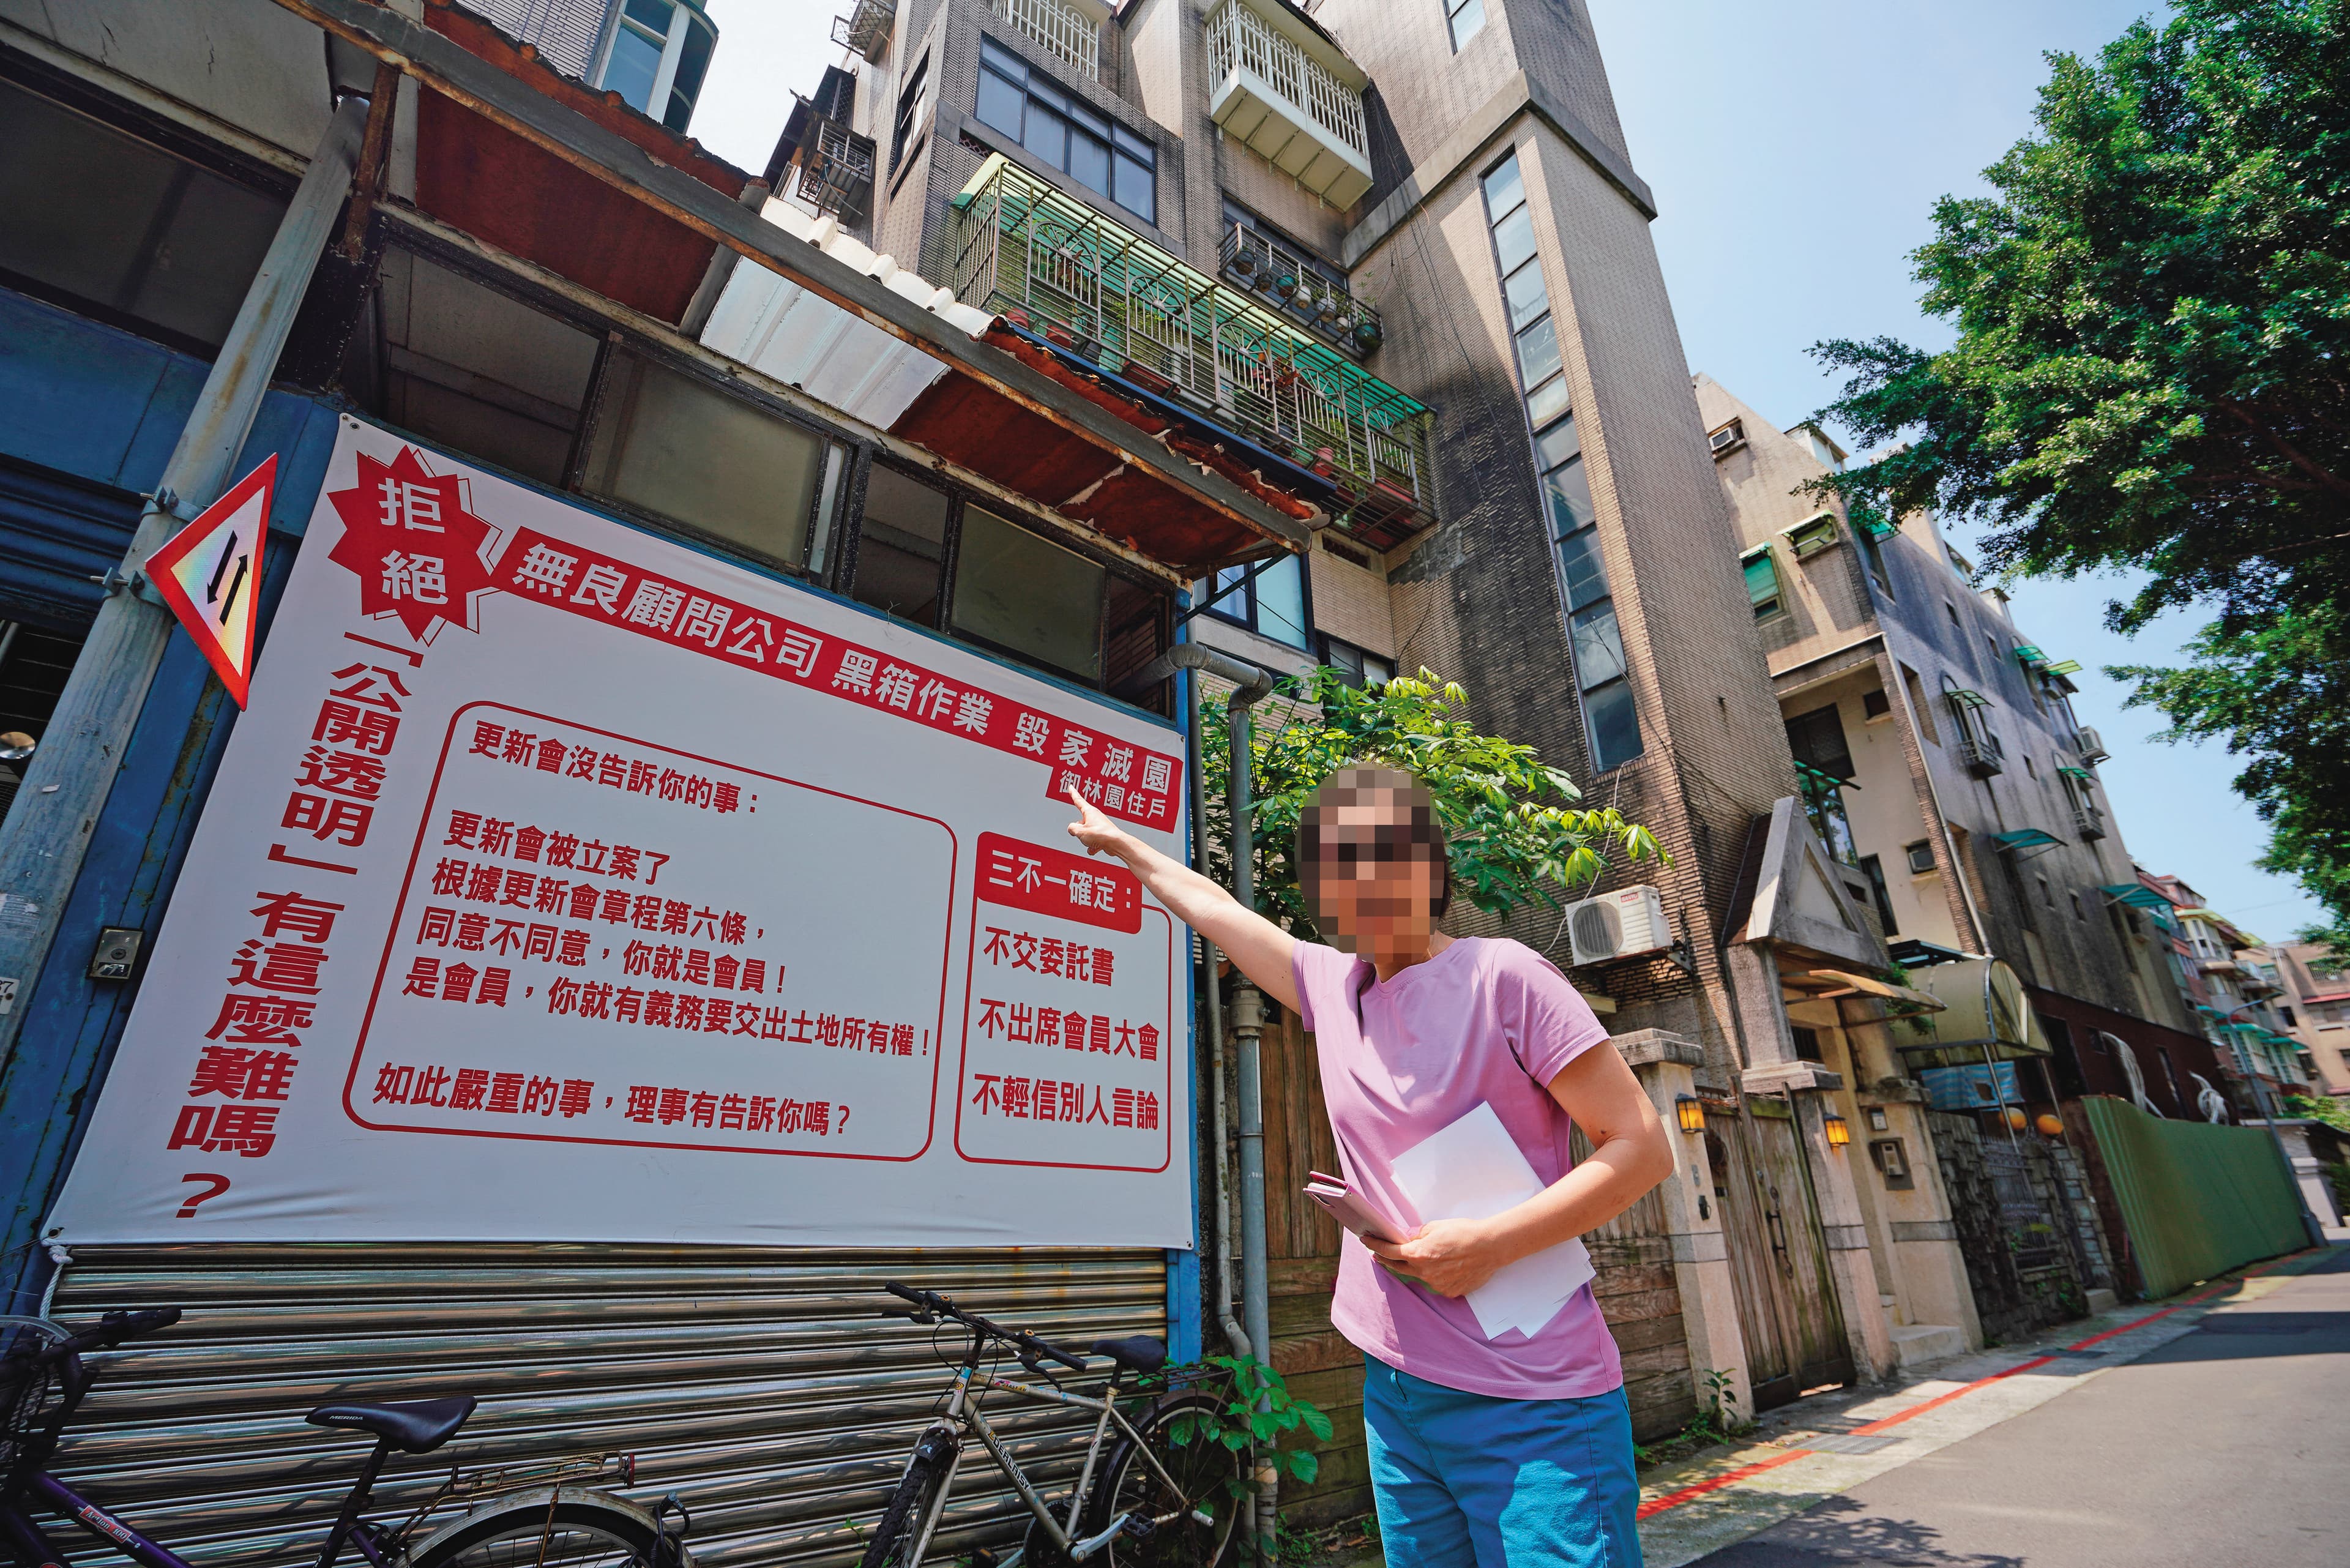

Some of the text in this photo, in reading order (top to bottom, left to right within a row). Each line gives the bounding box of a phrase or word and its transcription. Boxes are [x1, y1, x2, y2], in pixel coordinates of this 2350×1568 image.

[379, 477, 449, 604] 拒絕
[512, 541, 1172, 795] 無良顧問公司 黑箱作業 毀家滅園
[469, 720, 757, 813] 更新會沒告訴你的事：
[1059, 769, 1166, 819] 御林園住戶
[444, 810, 670, 885] 更新會被立案了
[989, 849, 1132, 914] 三不一確定：
[432, 857, 764, 946] 根據更新會章程第六條，
[417, 906, 786, 994] 同意不同意，你就是會員！
[983, 926, 1114, 987] 不交委託書
[978, 998, 1160, 1061] 不出席會員大會
[972, 1073, 1159, 1130] 不輕信別人言論
[85, 1510, 127, 1539] Action 100
